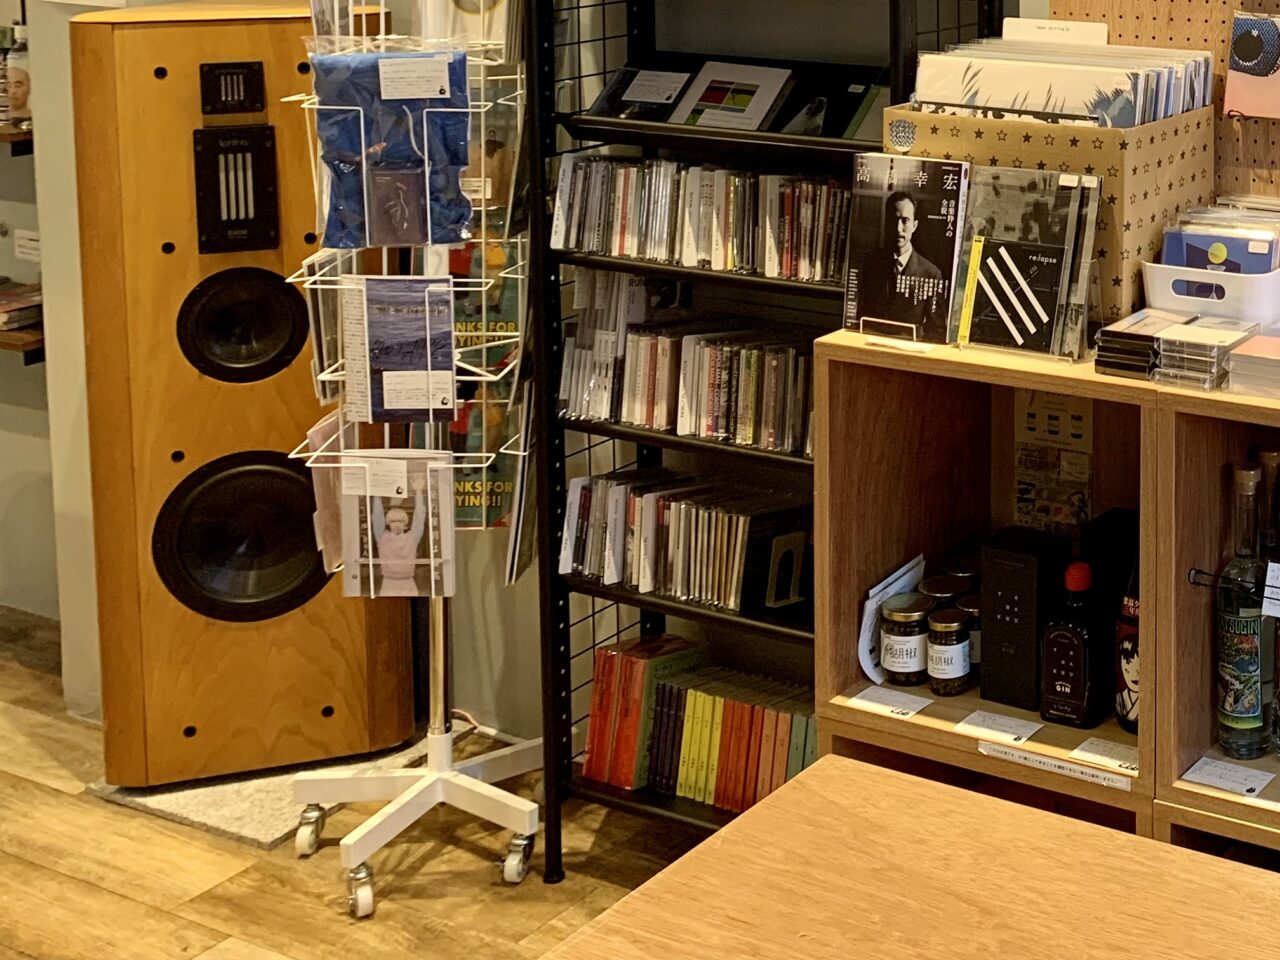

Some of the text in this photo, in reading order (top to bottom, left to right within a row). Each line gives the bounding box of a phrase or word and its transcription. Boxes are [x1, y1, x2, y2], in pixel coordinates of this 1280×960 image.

[1029, 253, 1057, 265] re:lapse
[489, 322, 515, 332] FOR
[486, 482, 513, 492] FOR
[1056, 685, 1071, 693] GIN
